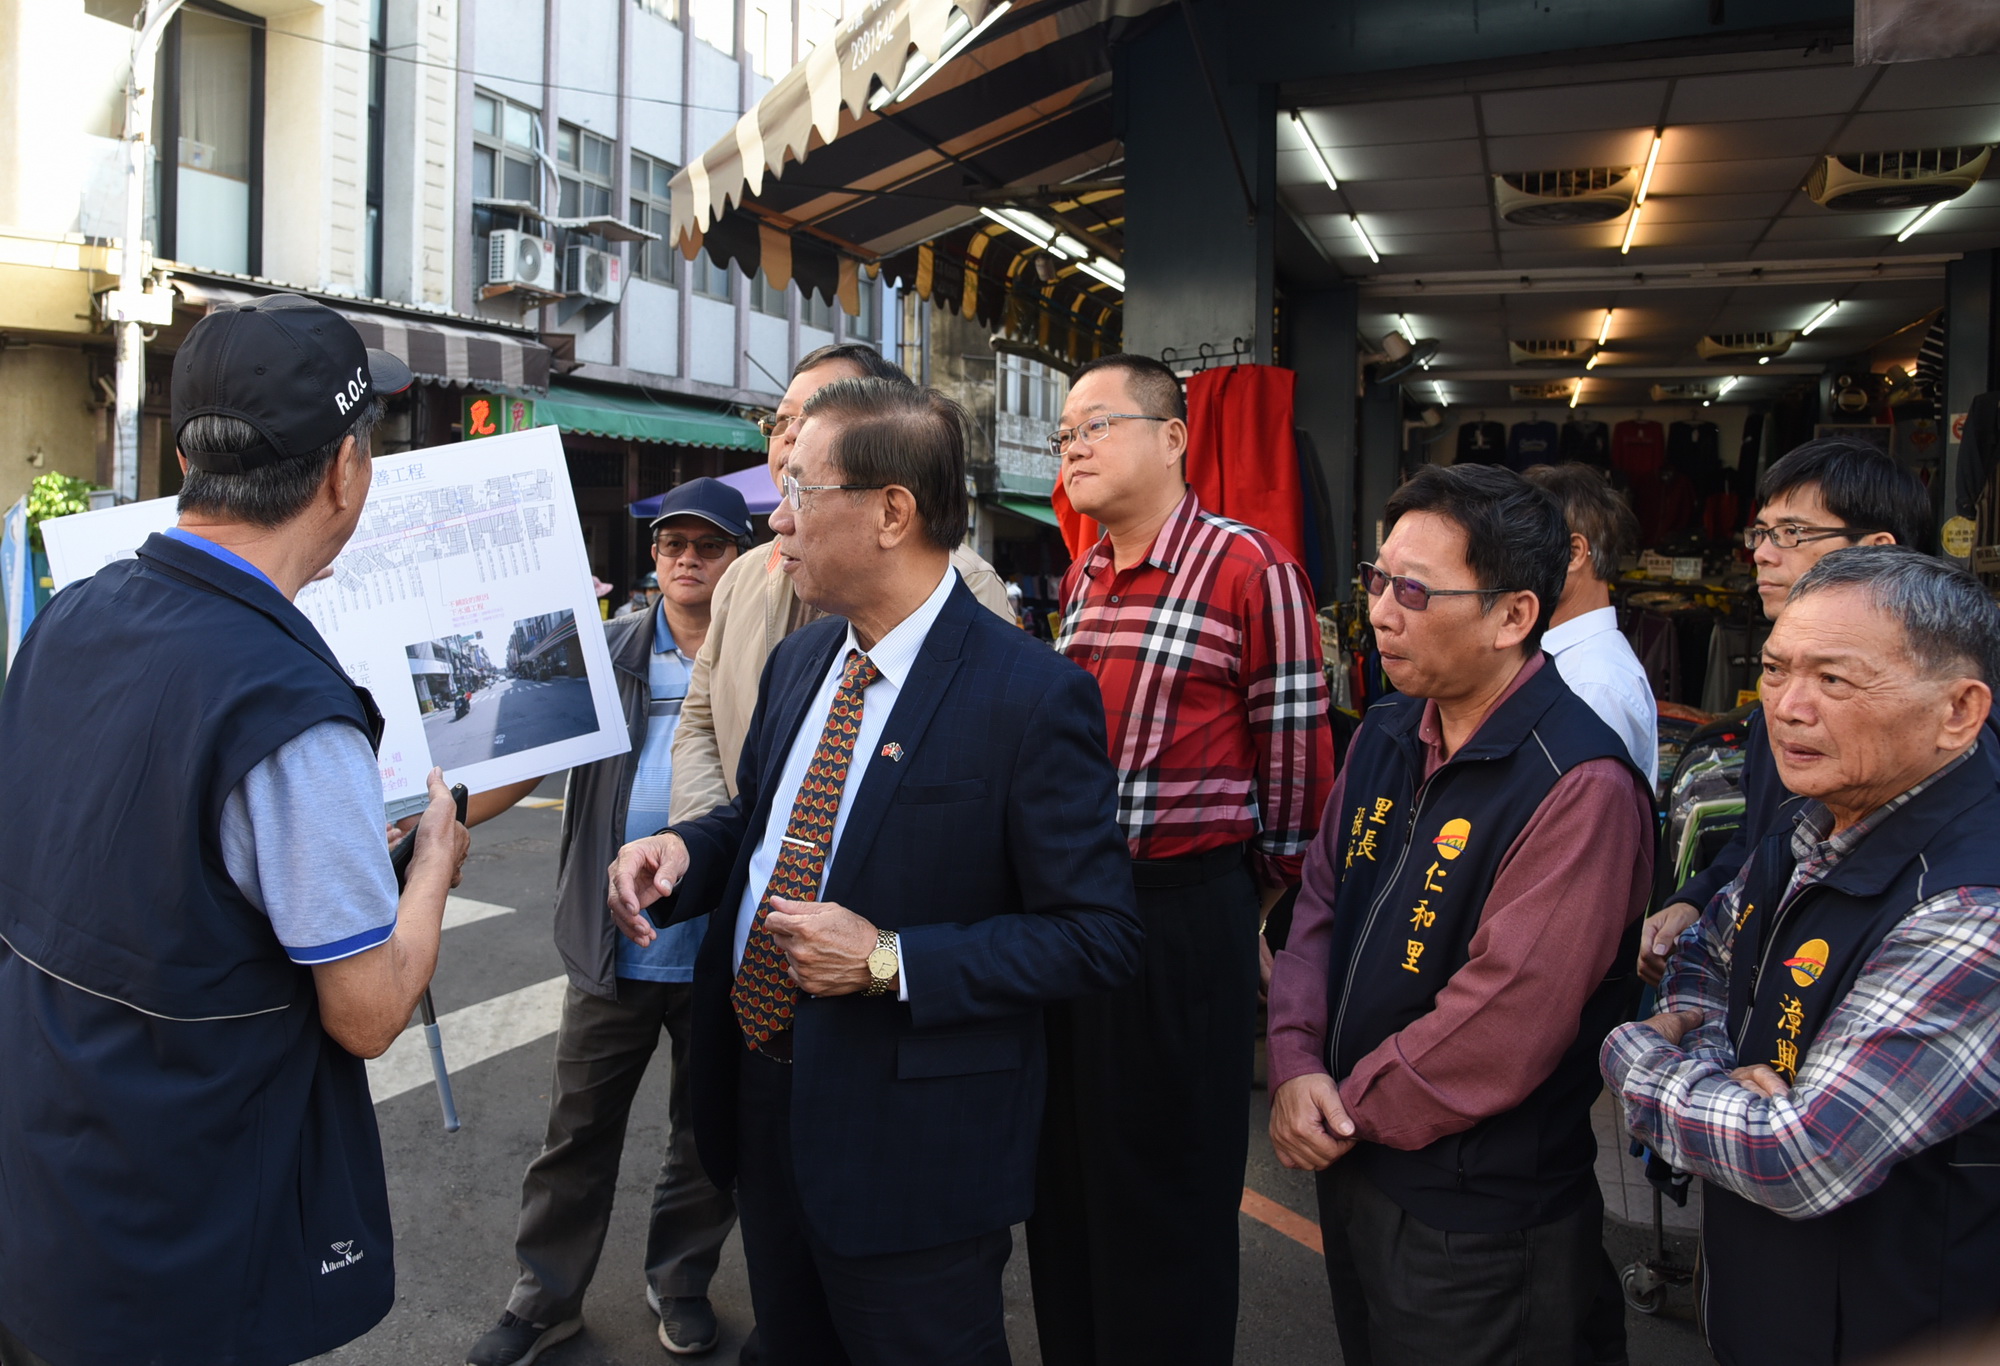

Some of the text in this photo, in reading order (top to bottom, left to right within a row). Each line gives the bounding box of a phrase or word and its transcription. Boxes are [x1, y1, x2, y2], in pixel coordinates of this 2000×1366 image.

[850, 10, 896, 71] 2331542
[371, 463, 427, 488] 善工程
[1356, 796, 1394, 861] 里長
[1401, 861, 1448, 974] 仁和里
